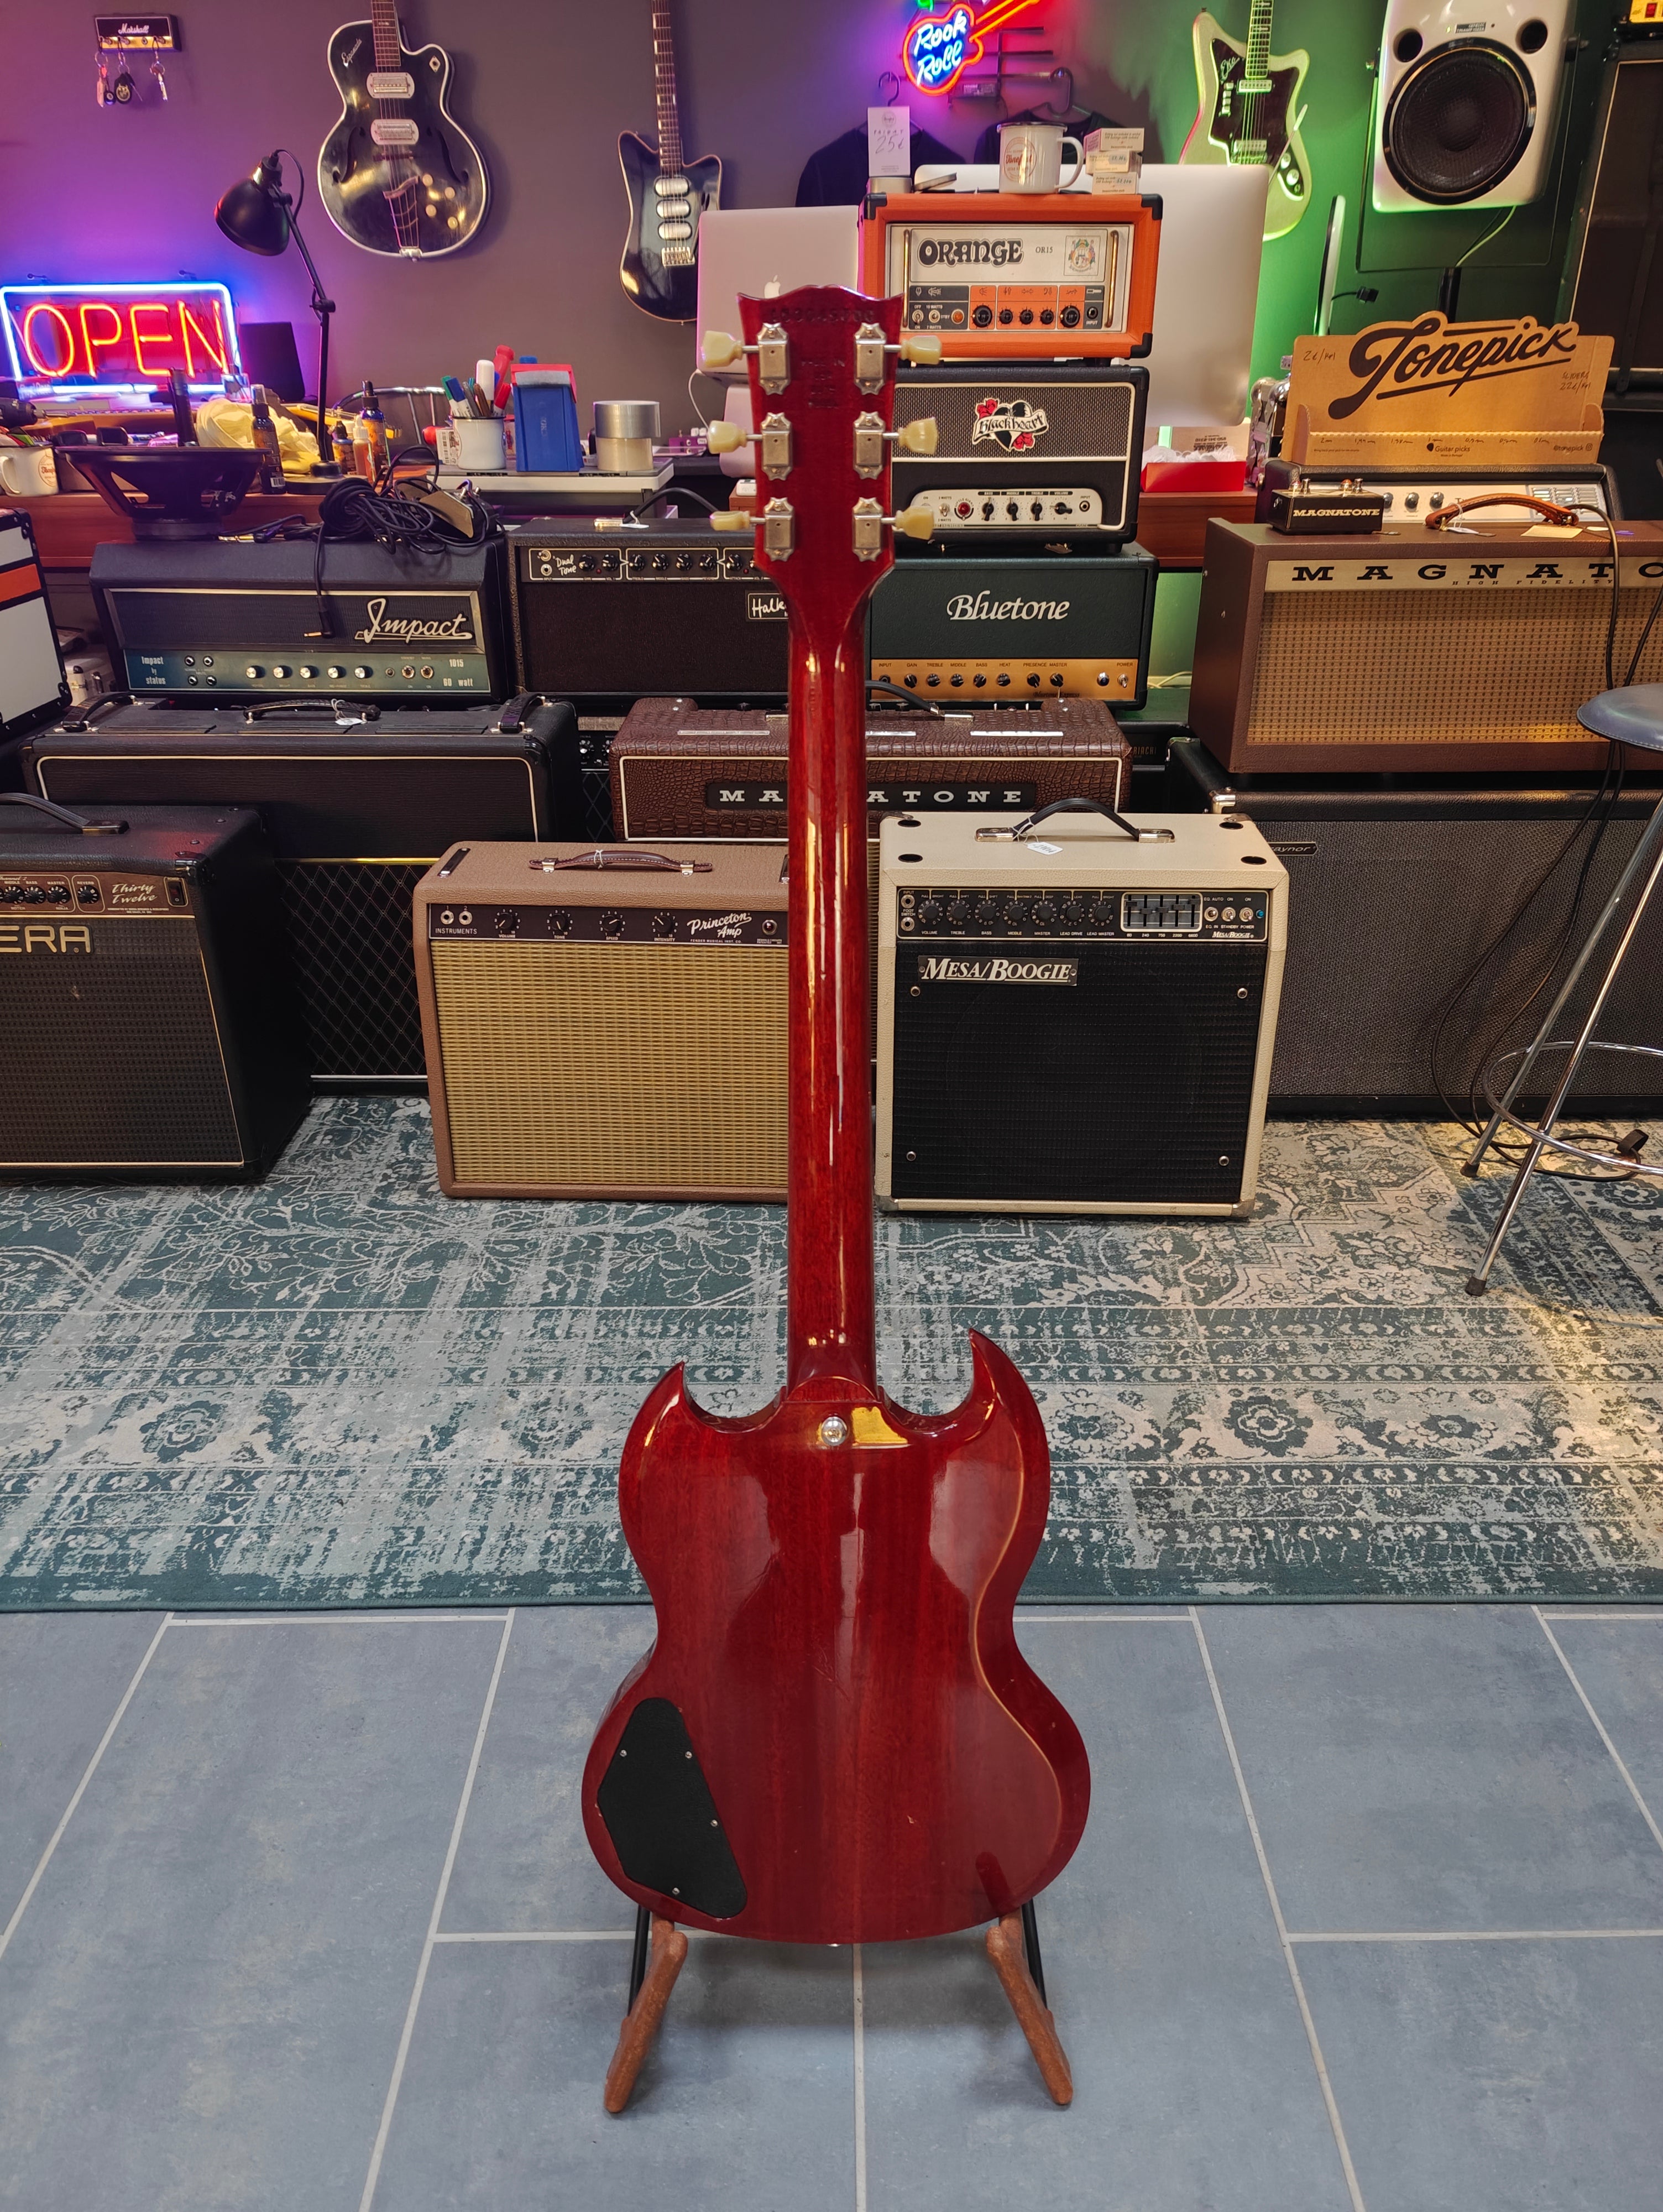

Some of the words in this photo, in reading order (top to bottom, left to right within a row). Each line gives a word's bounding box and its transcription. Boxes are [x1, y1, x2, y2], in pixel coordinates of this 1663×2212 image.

[118, 23, 149, 34] Marshall
[917, 39, 962, 87] Roll
[917, 238, 1023, 267] ORANGE
[24, 299, 229, 378] OPEN
[1329, 317, 1577, 420] Tonepick
[980, 414, 1044, 434] Blackheart
[1293, 509, 1380, 517] MAGNATONE
[555, 554, 574, 567] Dual
[558, 566, 577, 576] Tone
[946, 590, 1070, 620] Bluetone
[360, 598, 473, 643] Impact
[142, 656, 164, 665] Impact
[449, 659, 464, 667] 1015
[145, 676, 166, 685] status
[443, 678, 452, 686] 60
[458, 678, 473, 686] watt
[720, 790, 1022, 802] MAATONE
[112, 883, 156, 894] Thirty
[112, 893, 158, 904] Twelve
[687, 912, 752, 935] Princeton
[921, 958, 1072, 981] MESA/BOOGIE
